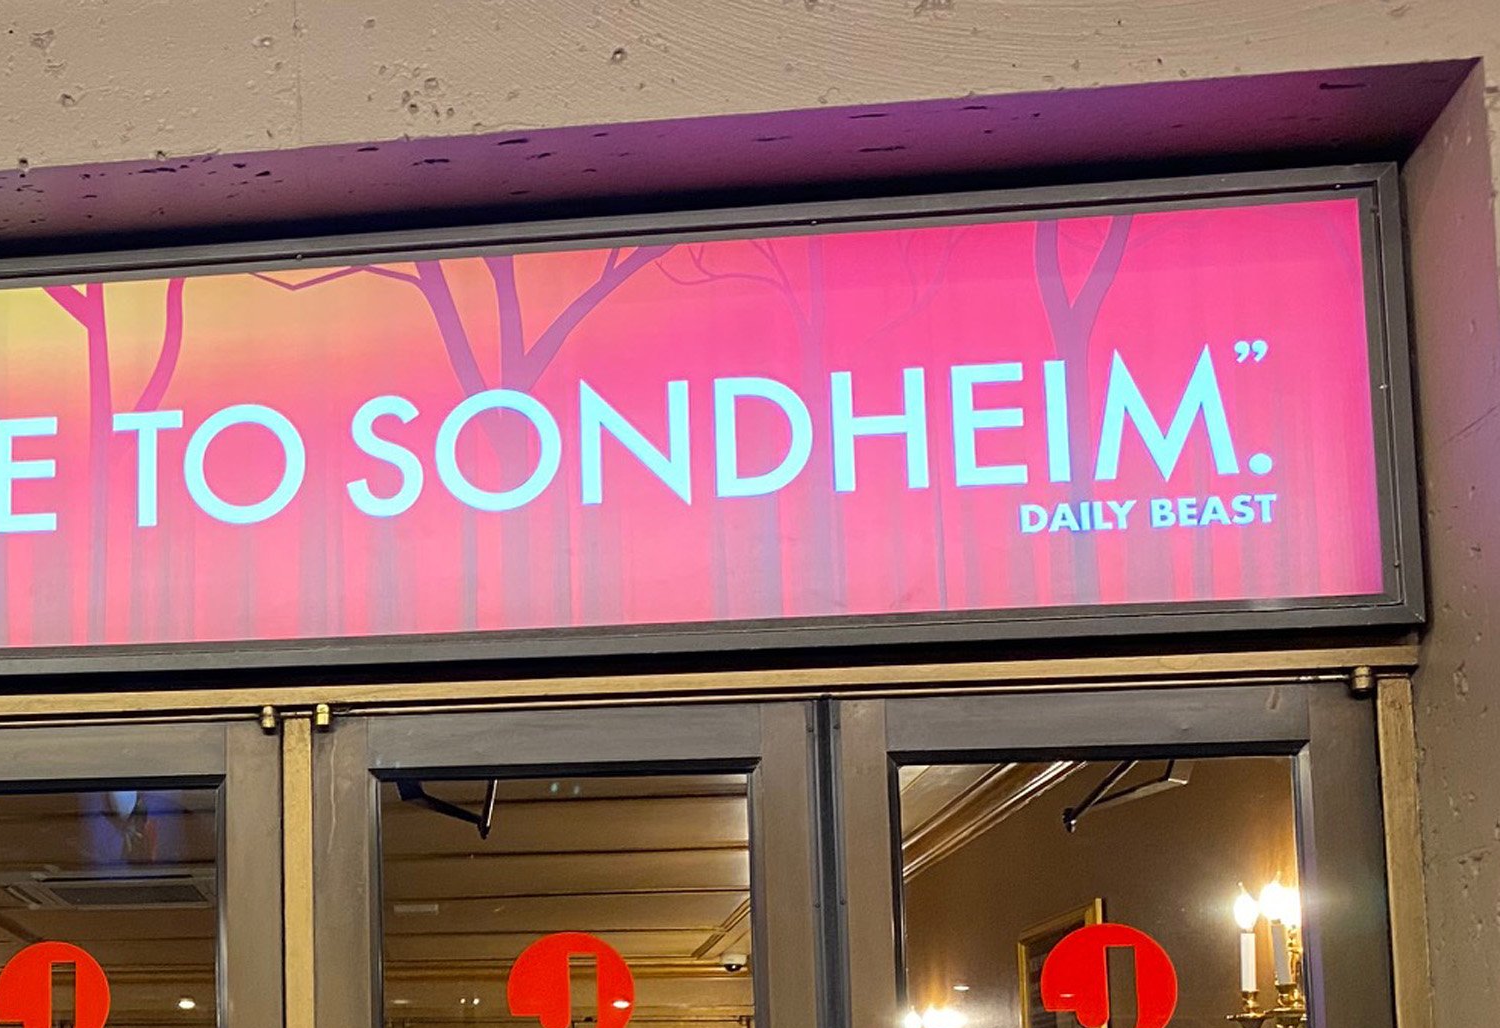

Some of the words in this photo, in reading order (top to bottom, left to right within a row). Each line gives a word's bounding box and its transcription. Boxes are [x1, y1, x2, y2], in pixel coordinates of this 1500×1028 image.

[113, 403, 306, 525] TO
[346, 339, 1273, 518] SONDHEIM.”
[1020, 499, 1138, 534] DAILY
[1150, 493, 1277, 529] BEAST
